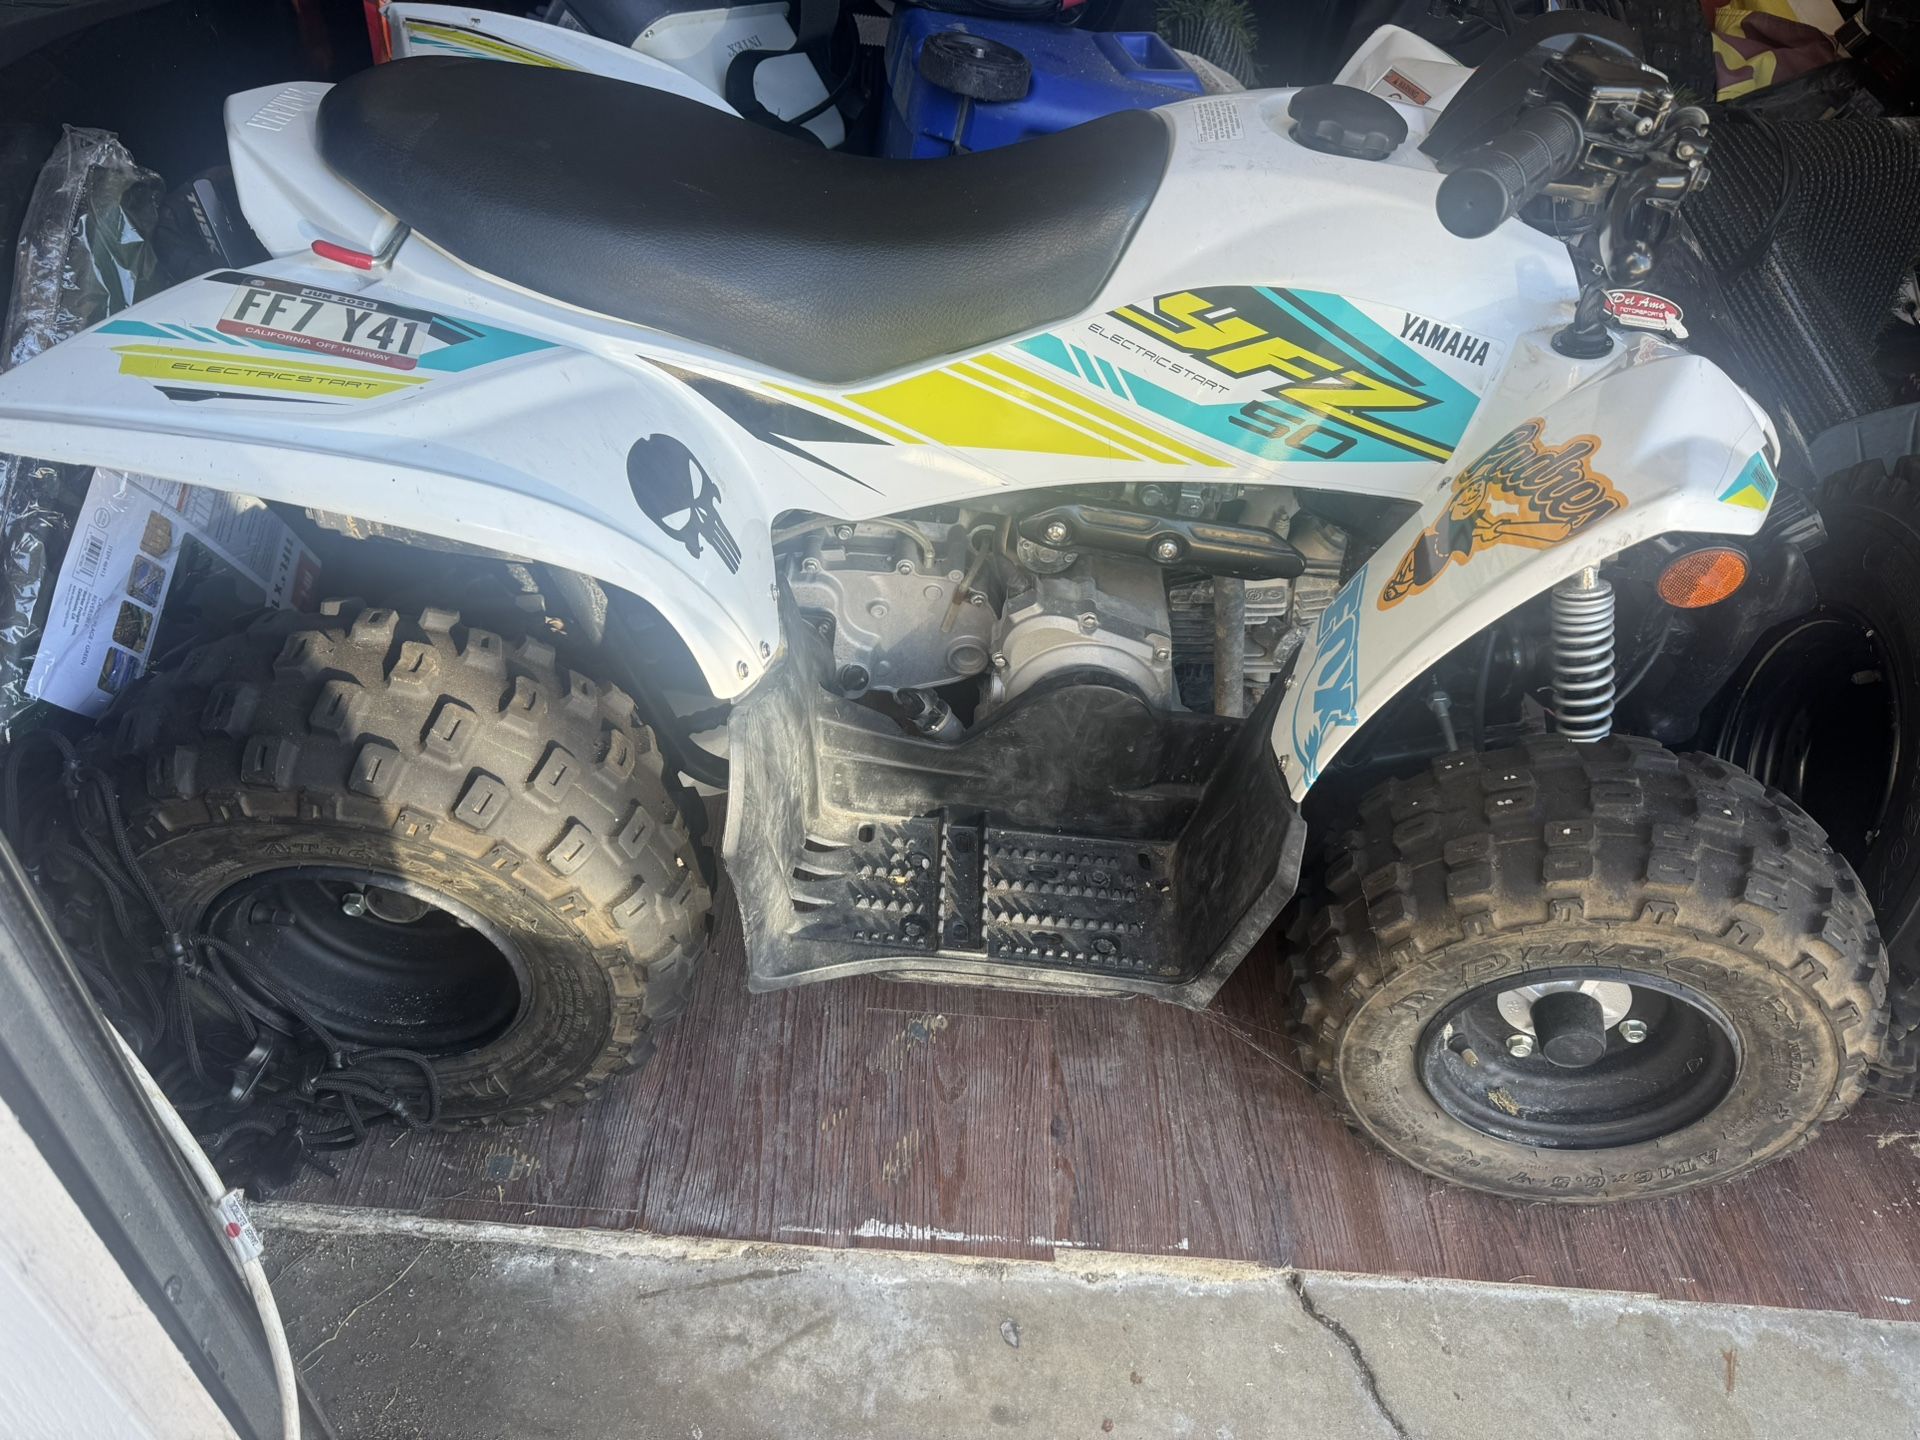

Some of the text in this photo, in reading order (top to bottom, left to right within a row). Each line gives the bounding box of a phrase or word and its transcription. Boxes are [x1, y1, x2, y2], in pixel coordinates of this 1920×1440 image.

[726, 34, 762, 55] INTEX
[186, 191, 221, 256] TUSK
[233, 289, 418, 356] FF7 Y41
[303, 289, 376, 309] JUN 2025
[1611, 292, 1666, 309] Del Amo
[245, 326, 391, 363] CALIFORNIA OFF HIGHWAY
[1400, 312, 1491, 366] YAMAHA
[1106, 291, 1453, 463] YFZ
[1228, 400, 1358, 460] 50
[1458, 422, 1622, 528] Padres
[79, 644, 91, 666] GREEN
